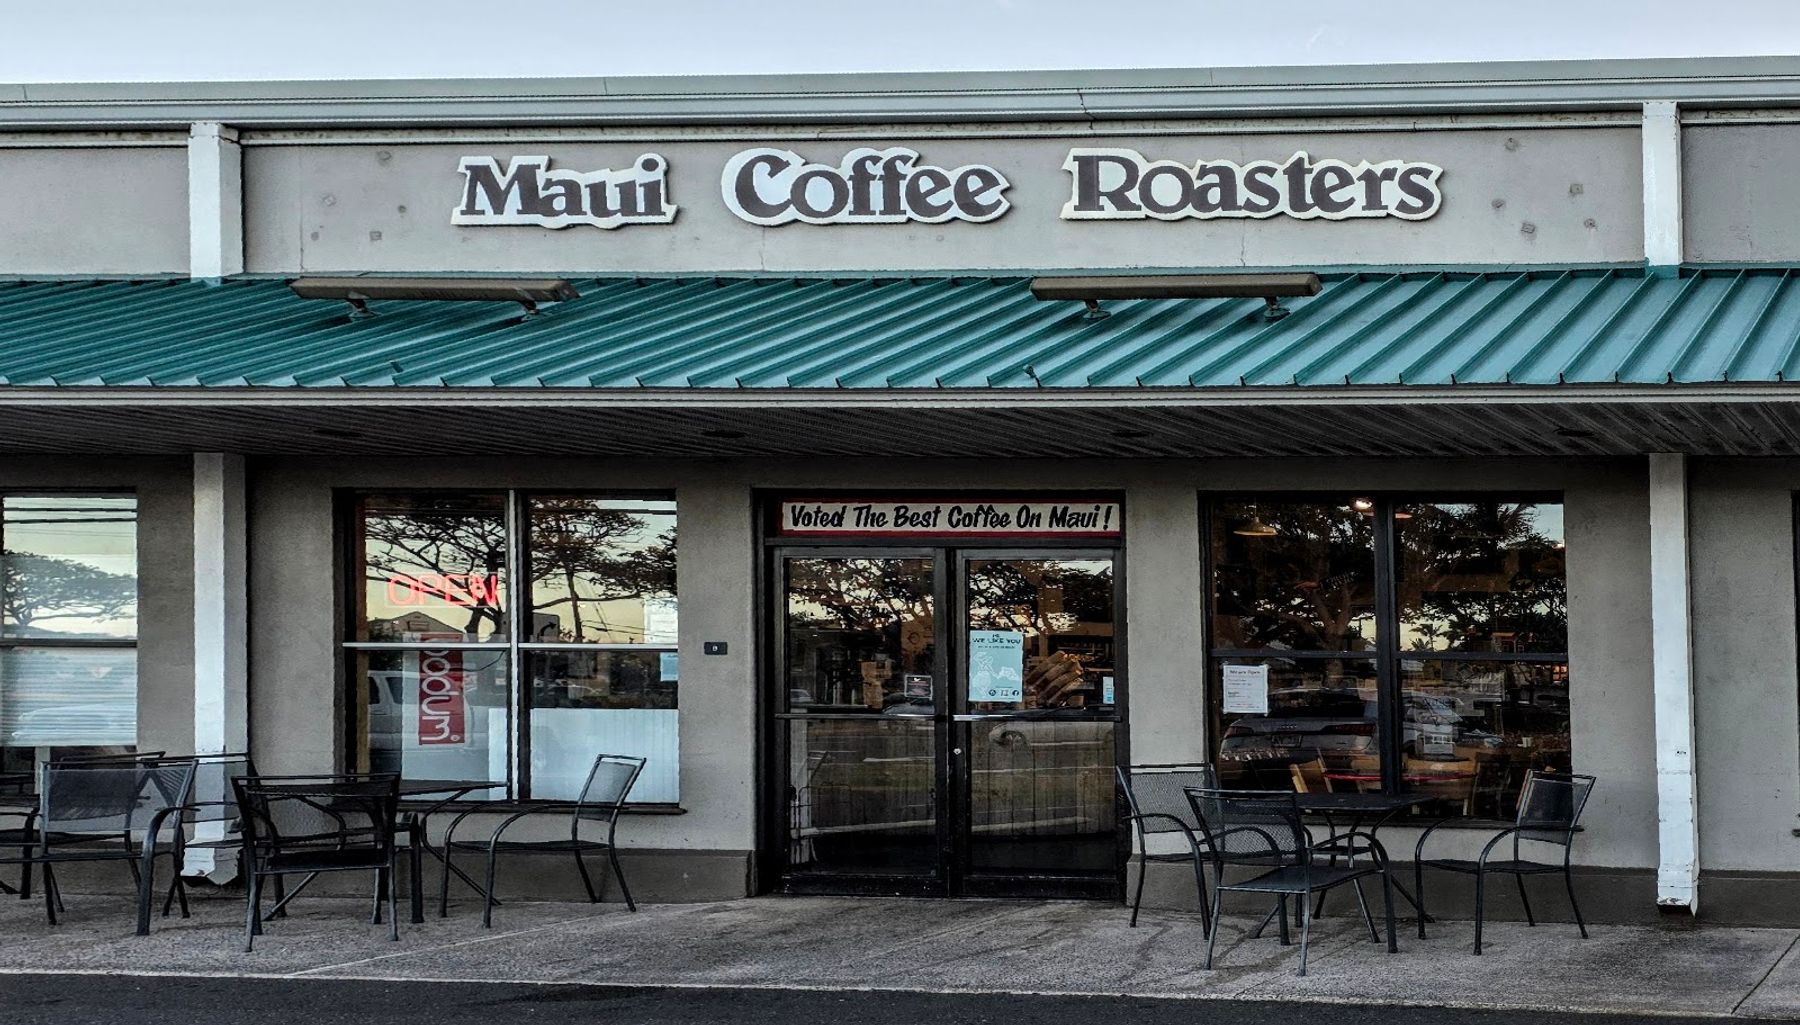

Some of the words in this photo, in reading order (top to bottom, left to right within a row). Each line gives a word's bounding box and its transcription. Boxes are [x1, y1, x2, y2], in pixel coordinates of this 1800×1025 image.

[464, 157, 668, 219] Maui
[734, 153, 1004, 219] Coffee
[1072, 154, 1440, 214] Roasters
[790, 504, 848, 528] Voted
[853, 504, 889, 528] The
[893, 505, 941, 528] Best
[947, 504, 1011, 528] Coffee
[1016, 504, 1042, 529] On
[1048, 504, 1113, 530] Maui!
[388, 574, 497, 605] OPEN
